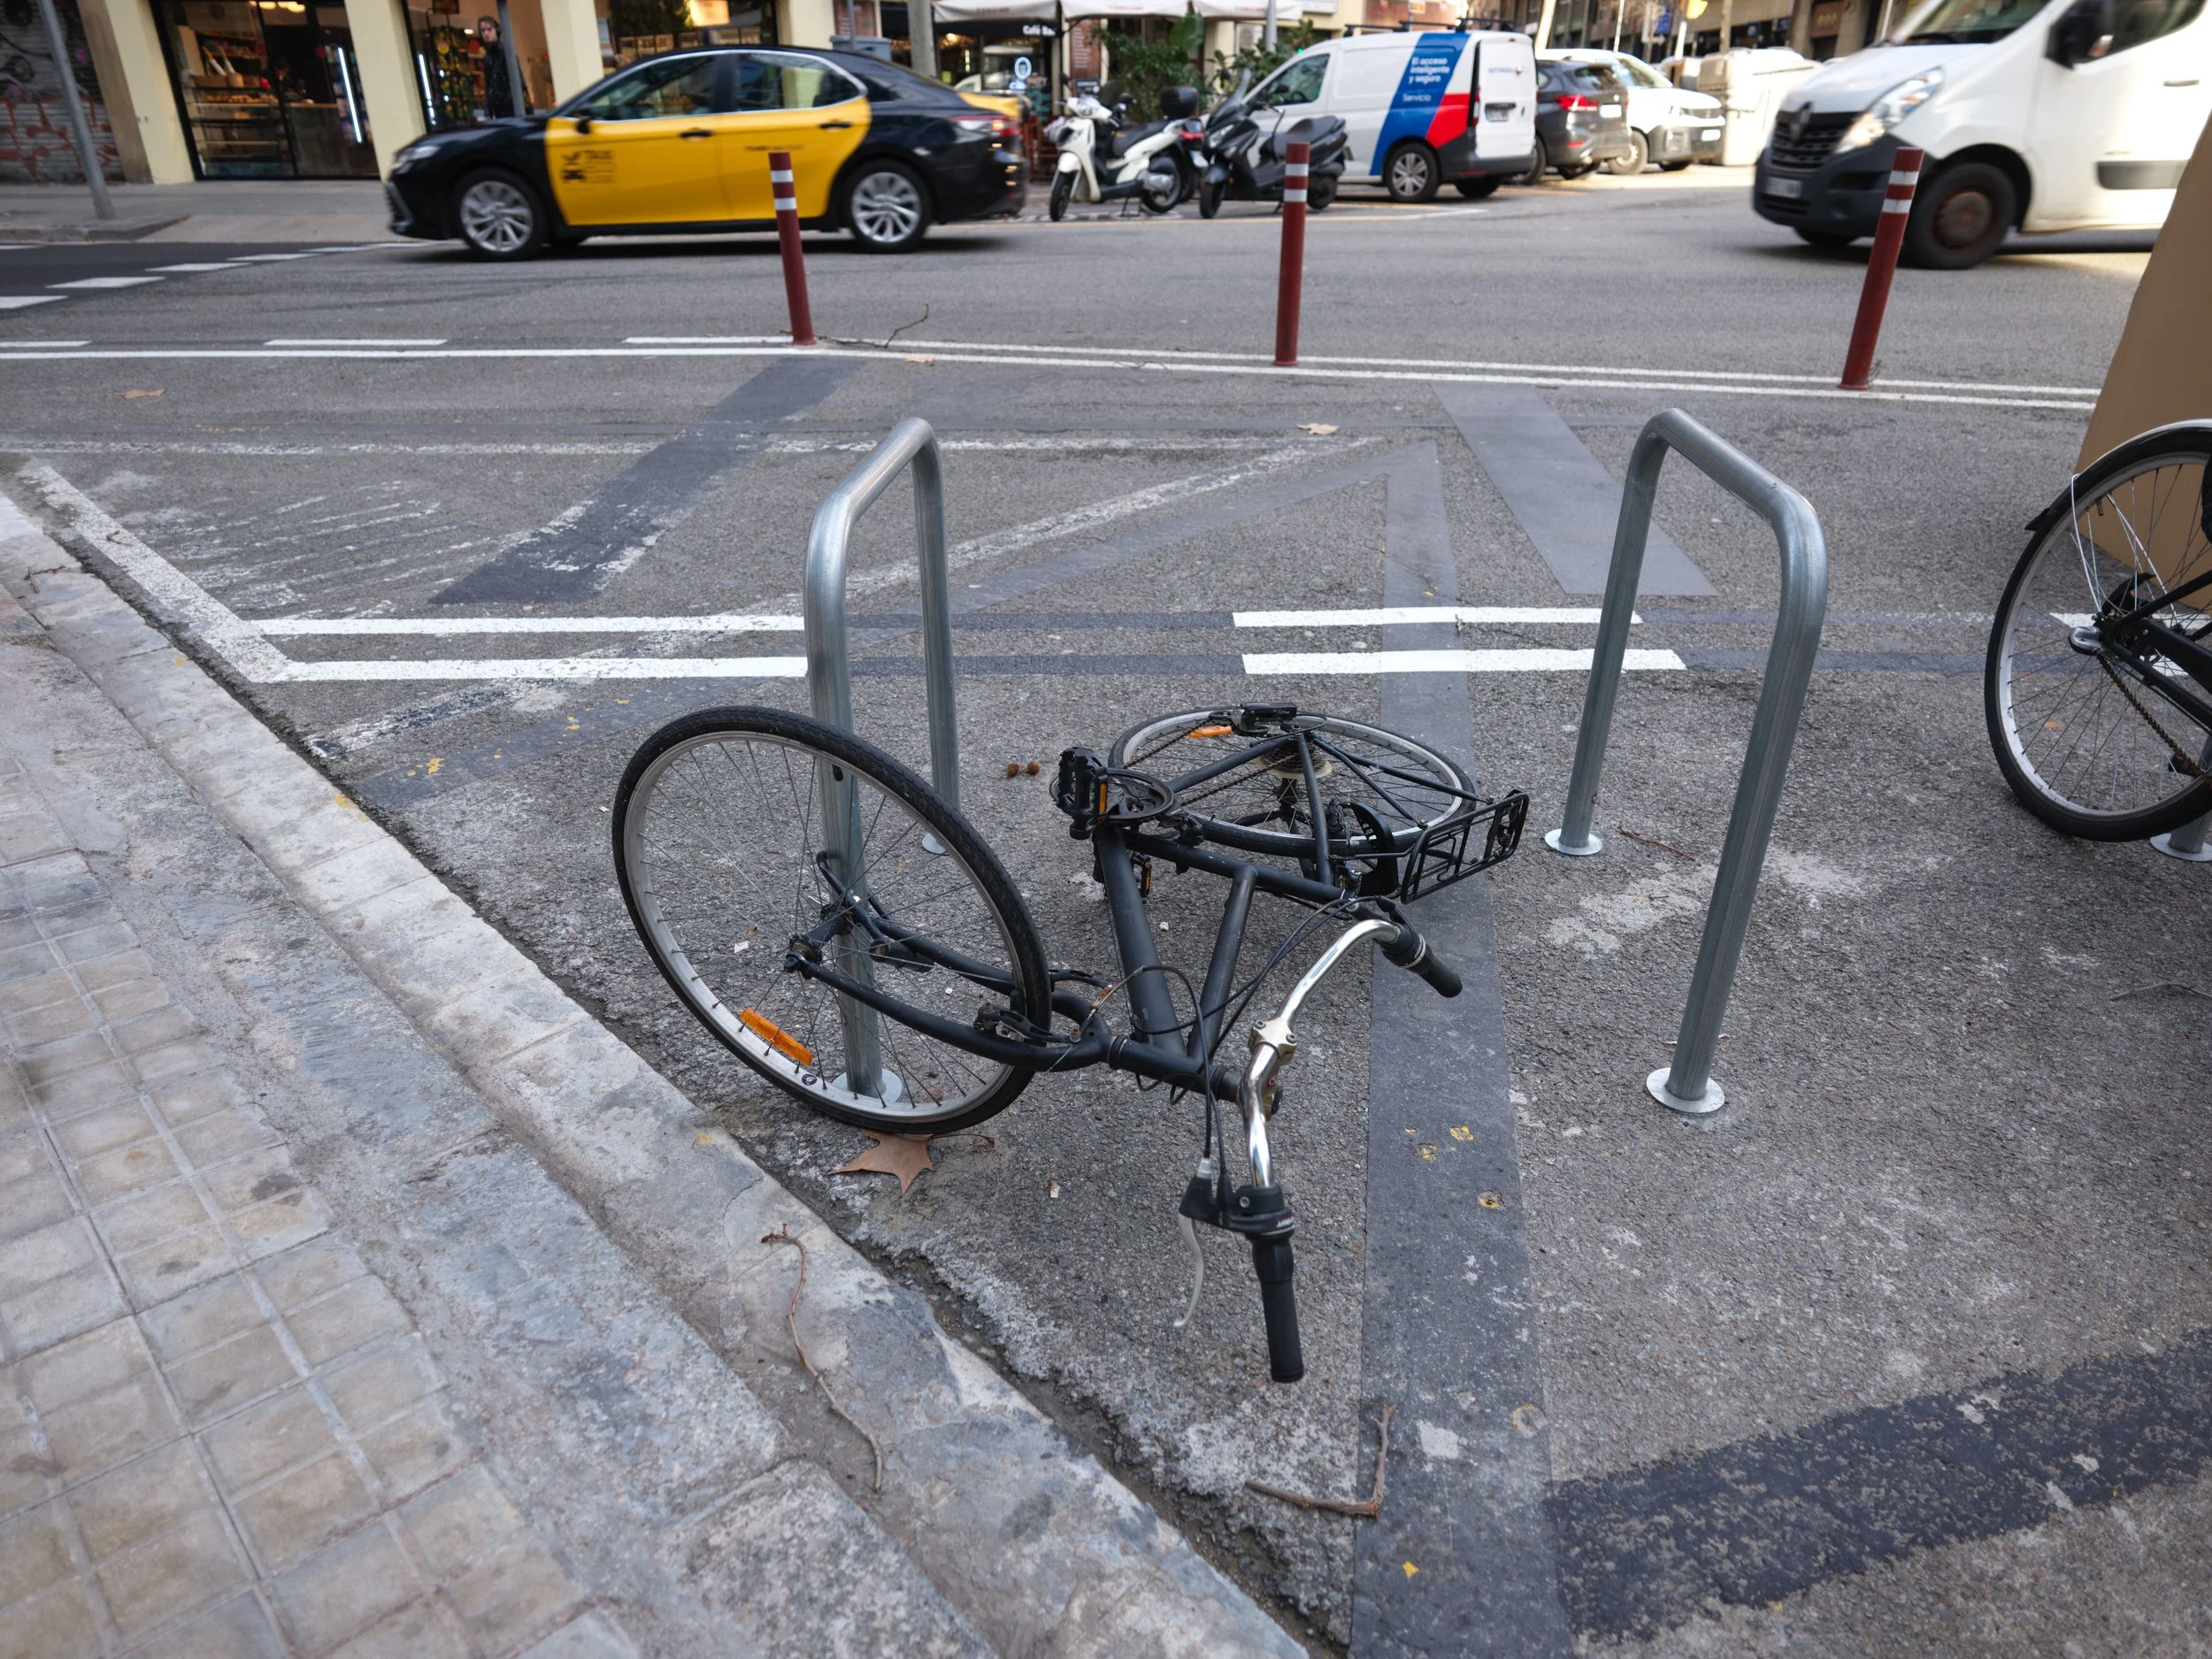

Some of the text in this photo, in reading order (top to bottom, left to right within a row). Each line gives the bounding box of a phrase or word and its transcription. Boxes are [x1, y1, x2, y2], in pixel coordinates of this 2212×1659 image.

[1022, 25, 1041, 35] Café
[1410, 65, 1450, 74] inteligente
[1409, 75, 1441, 85] y seguro
